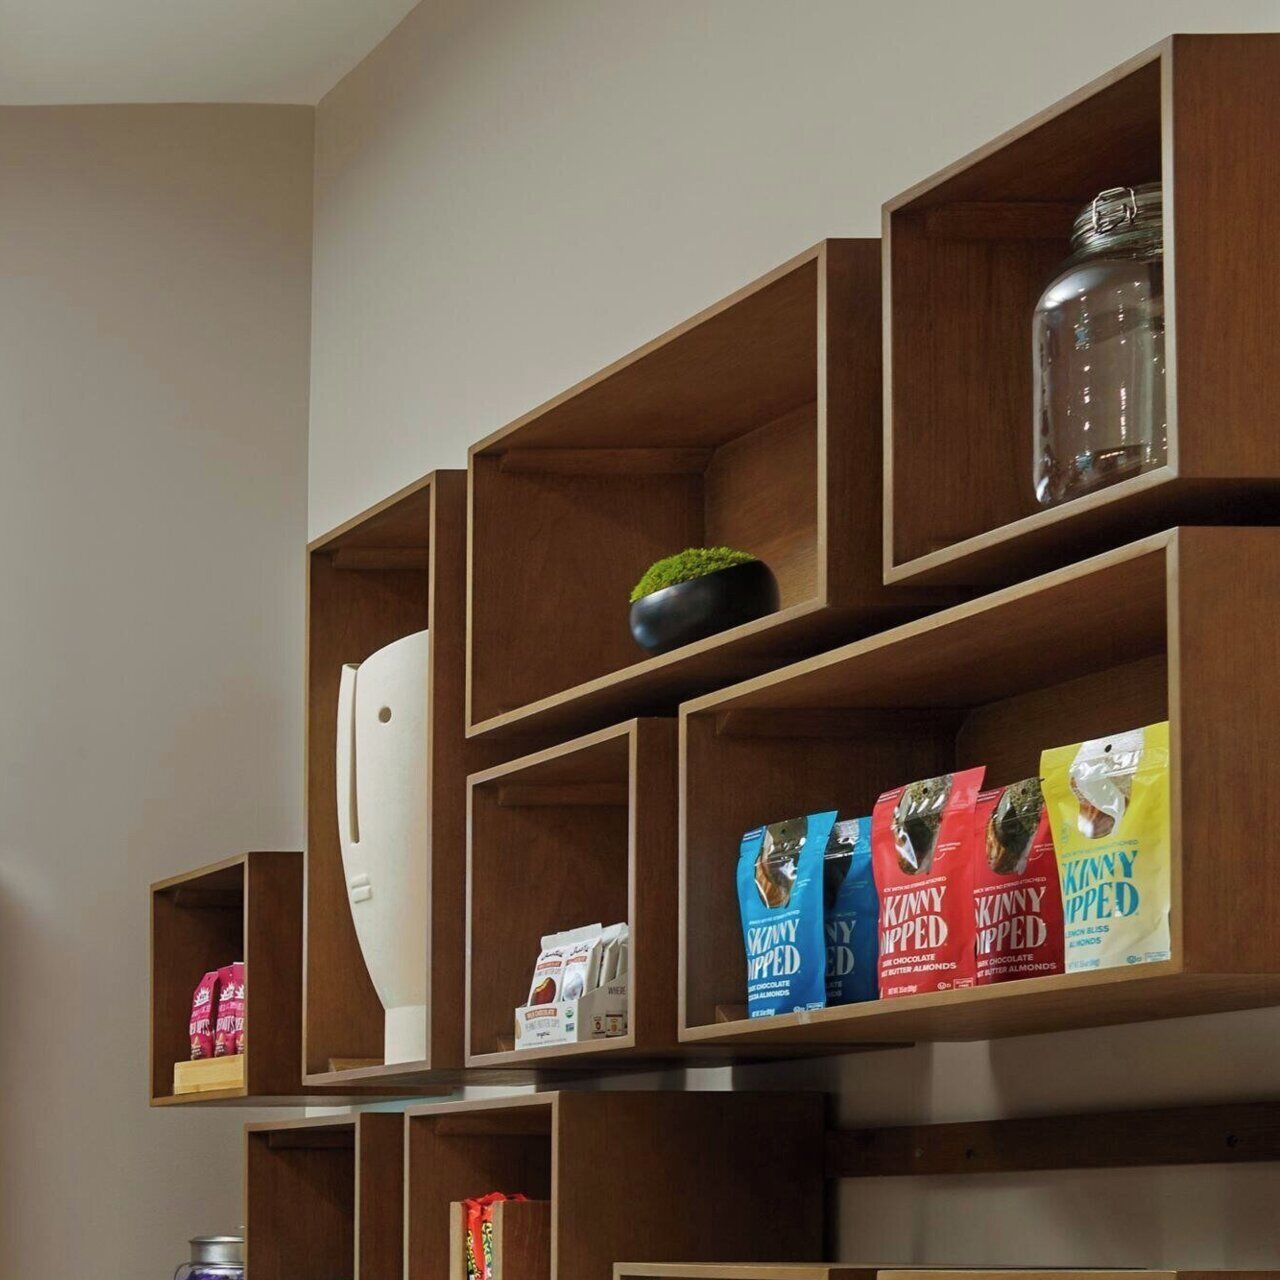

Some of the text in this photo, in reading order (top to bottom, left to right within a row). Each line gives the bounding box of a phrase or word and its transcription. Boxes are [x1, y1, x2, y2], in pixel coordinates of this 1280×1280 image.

[1062, 851, 1138, 895] KINNY
[884, 886, 946, 923] KINNY
[1065, 882, 1139, 923] IPPED
[1087, 925, 1109, 933] BLISS
[748, 919, 800, 955] SKINNY
[893, 954, 936, 963] CHOCOLATE
[990, 954, 1033, 965] CHOCOLATE
[889, 963, 956, 976] BUTTER ALMONDS
[1009, 963, 1056, 972] ALMONDS
